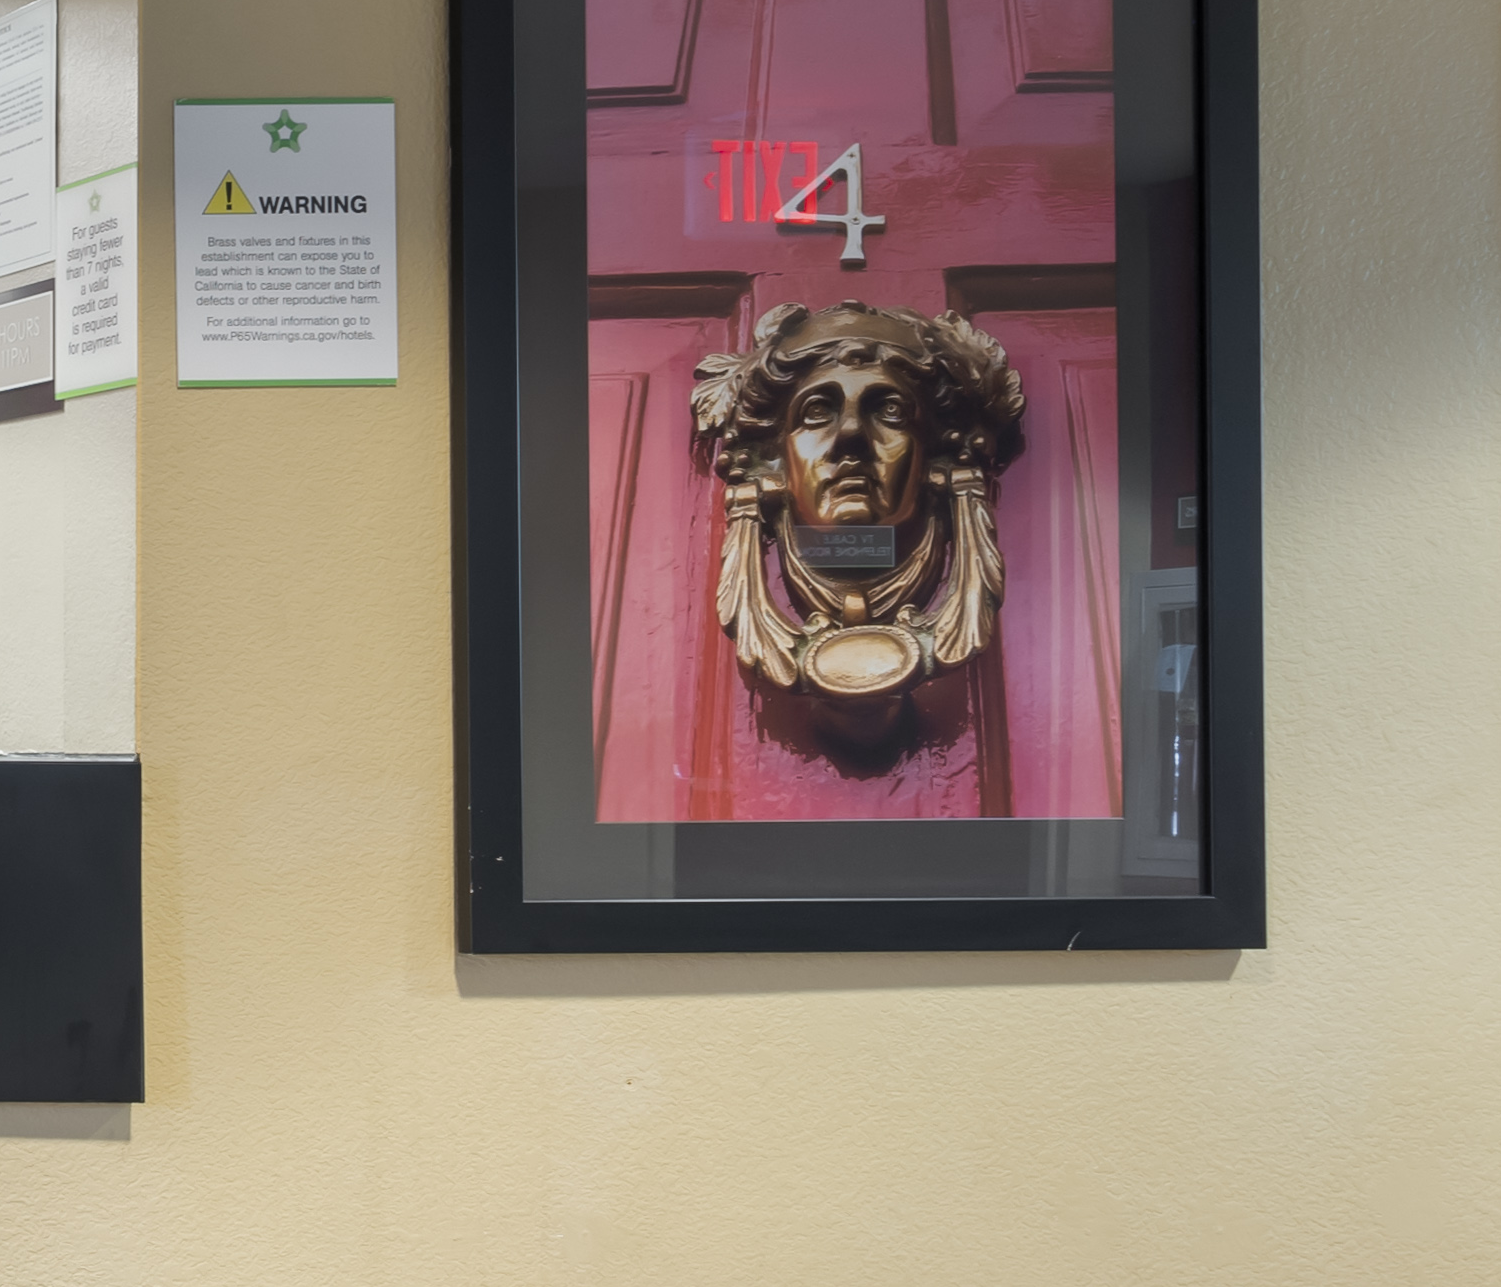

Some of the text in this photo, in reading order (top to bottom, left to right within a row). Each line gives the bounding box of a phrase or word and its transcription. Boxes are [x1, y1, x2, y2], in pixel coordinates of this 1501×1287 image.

[259, 195, 367, 214] WARNING
[775, 142, 886, 268] 4
[72, 217, 118, 241] For guests
[67, 235, 124, 262] staying fewer
[208, 236, 371, 247] Brass valves and fixtures in this
[66, 254, 124, 280] than 7 nights,
[201, 251, 374, 263] establishment can expose you to
[195, 264, 380, 276] lead which is known to the State of
[80, 276, 110, 296] a valid
[195, 280, 382, 291] California to cause cancer and birth
[72, 293, 118, 316] credit card
[196, 294, 380, 307] defects or other reproductive harm.
[72, 312, 118, 336] is required
[206, 316, 371, 327] For additional information go to
[68, 333, 122, 356] for payment.
[1, 346, 31, 370] 11PM
